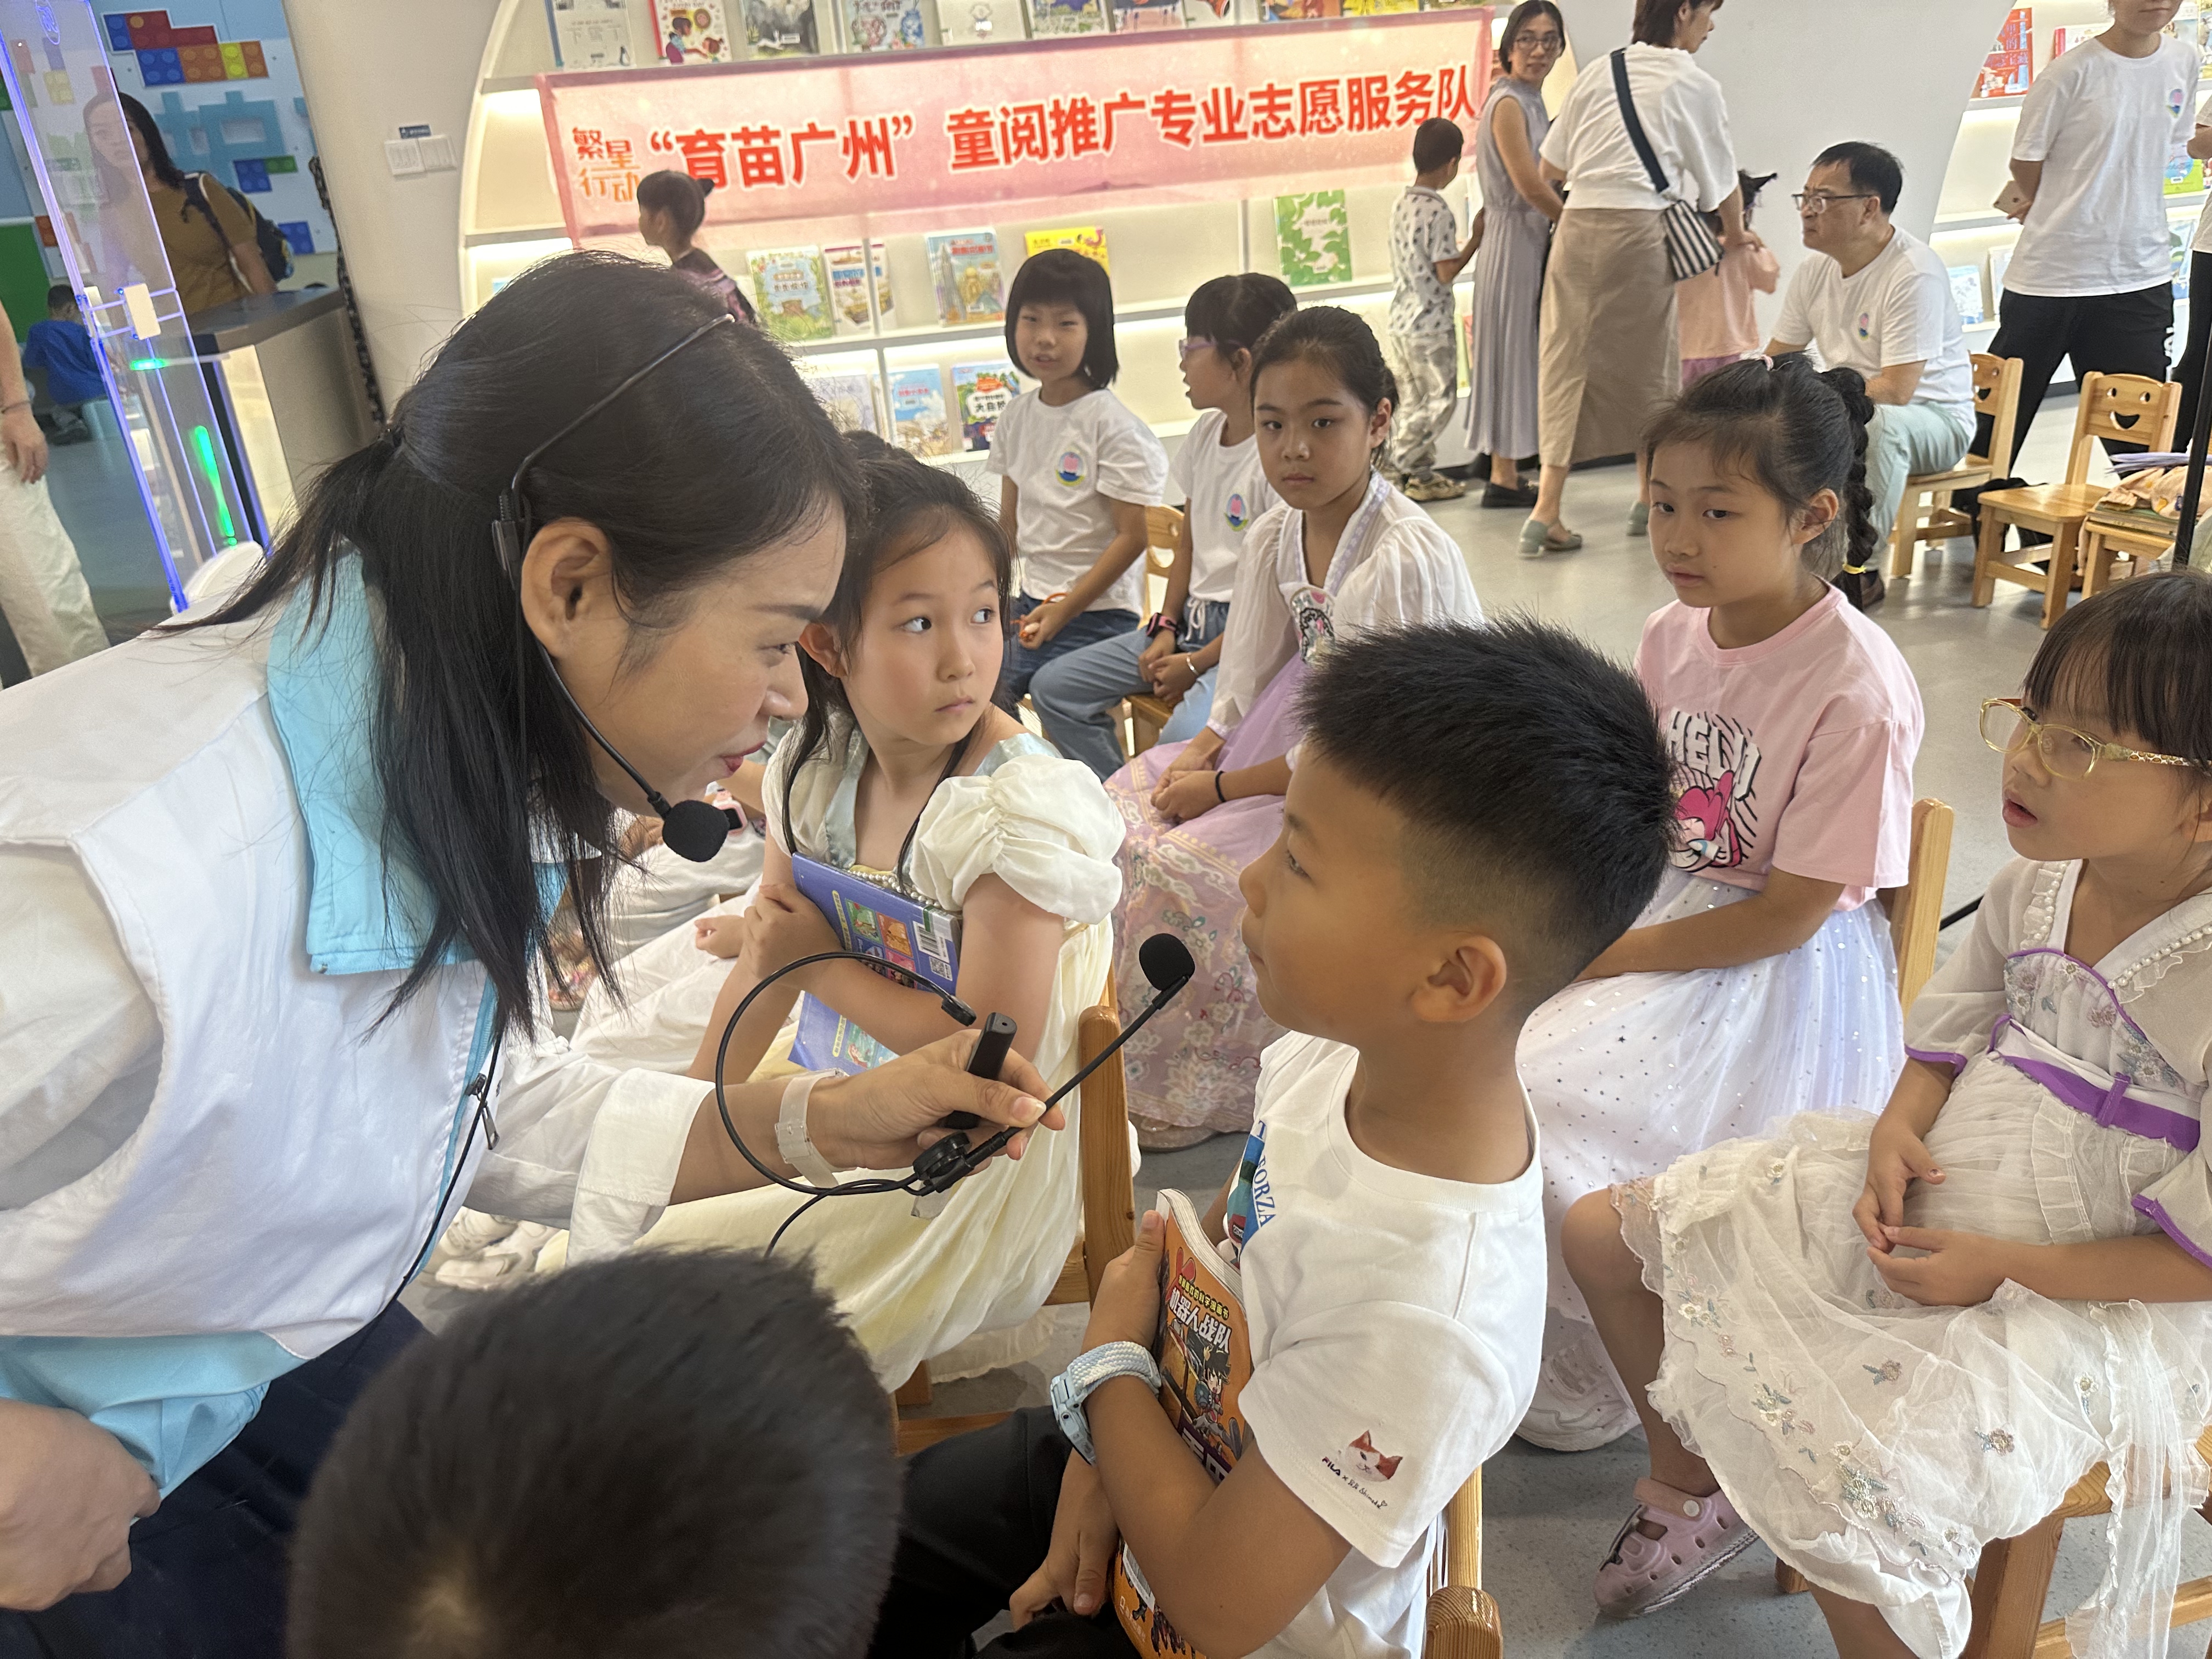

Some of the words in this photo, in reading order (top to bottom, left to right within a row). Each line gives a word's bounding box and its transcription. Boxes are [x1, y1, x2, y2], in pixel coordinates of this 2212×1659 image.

[572, 127, 633, 167] 繁星
[651, 116, 913, 188] “育苗广州”
[947, 65, 1475, 170] 童阅推广专业志愿服务队
[579, 166, 641, 201] 行动
[1254, 1155, 1276, 1228] FORZA
[1169, 1286, 1232, 1353] 机器人战队
[1322, 1456, 1340, 1476] FILA
